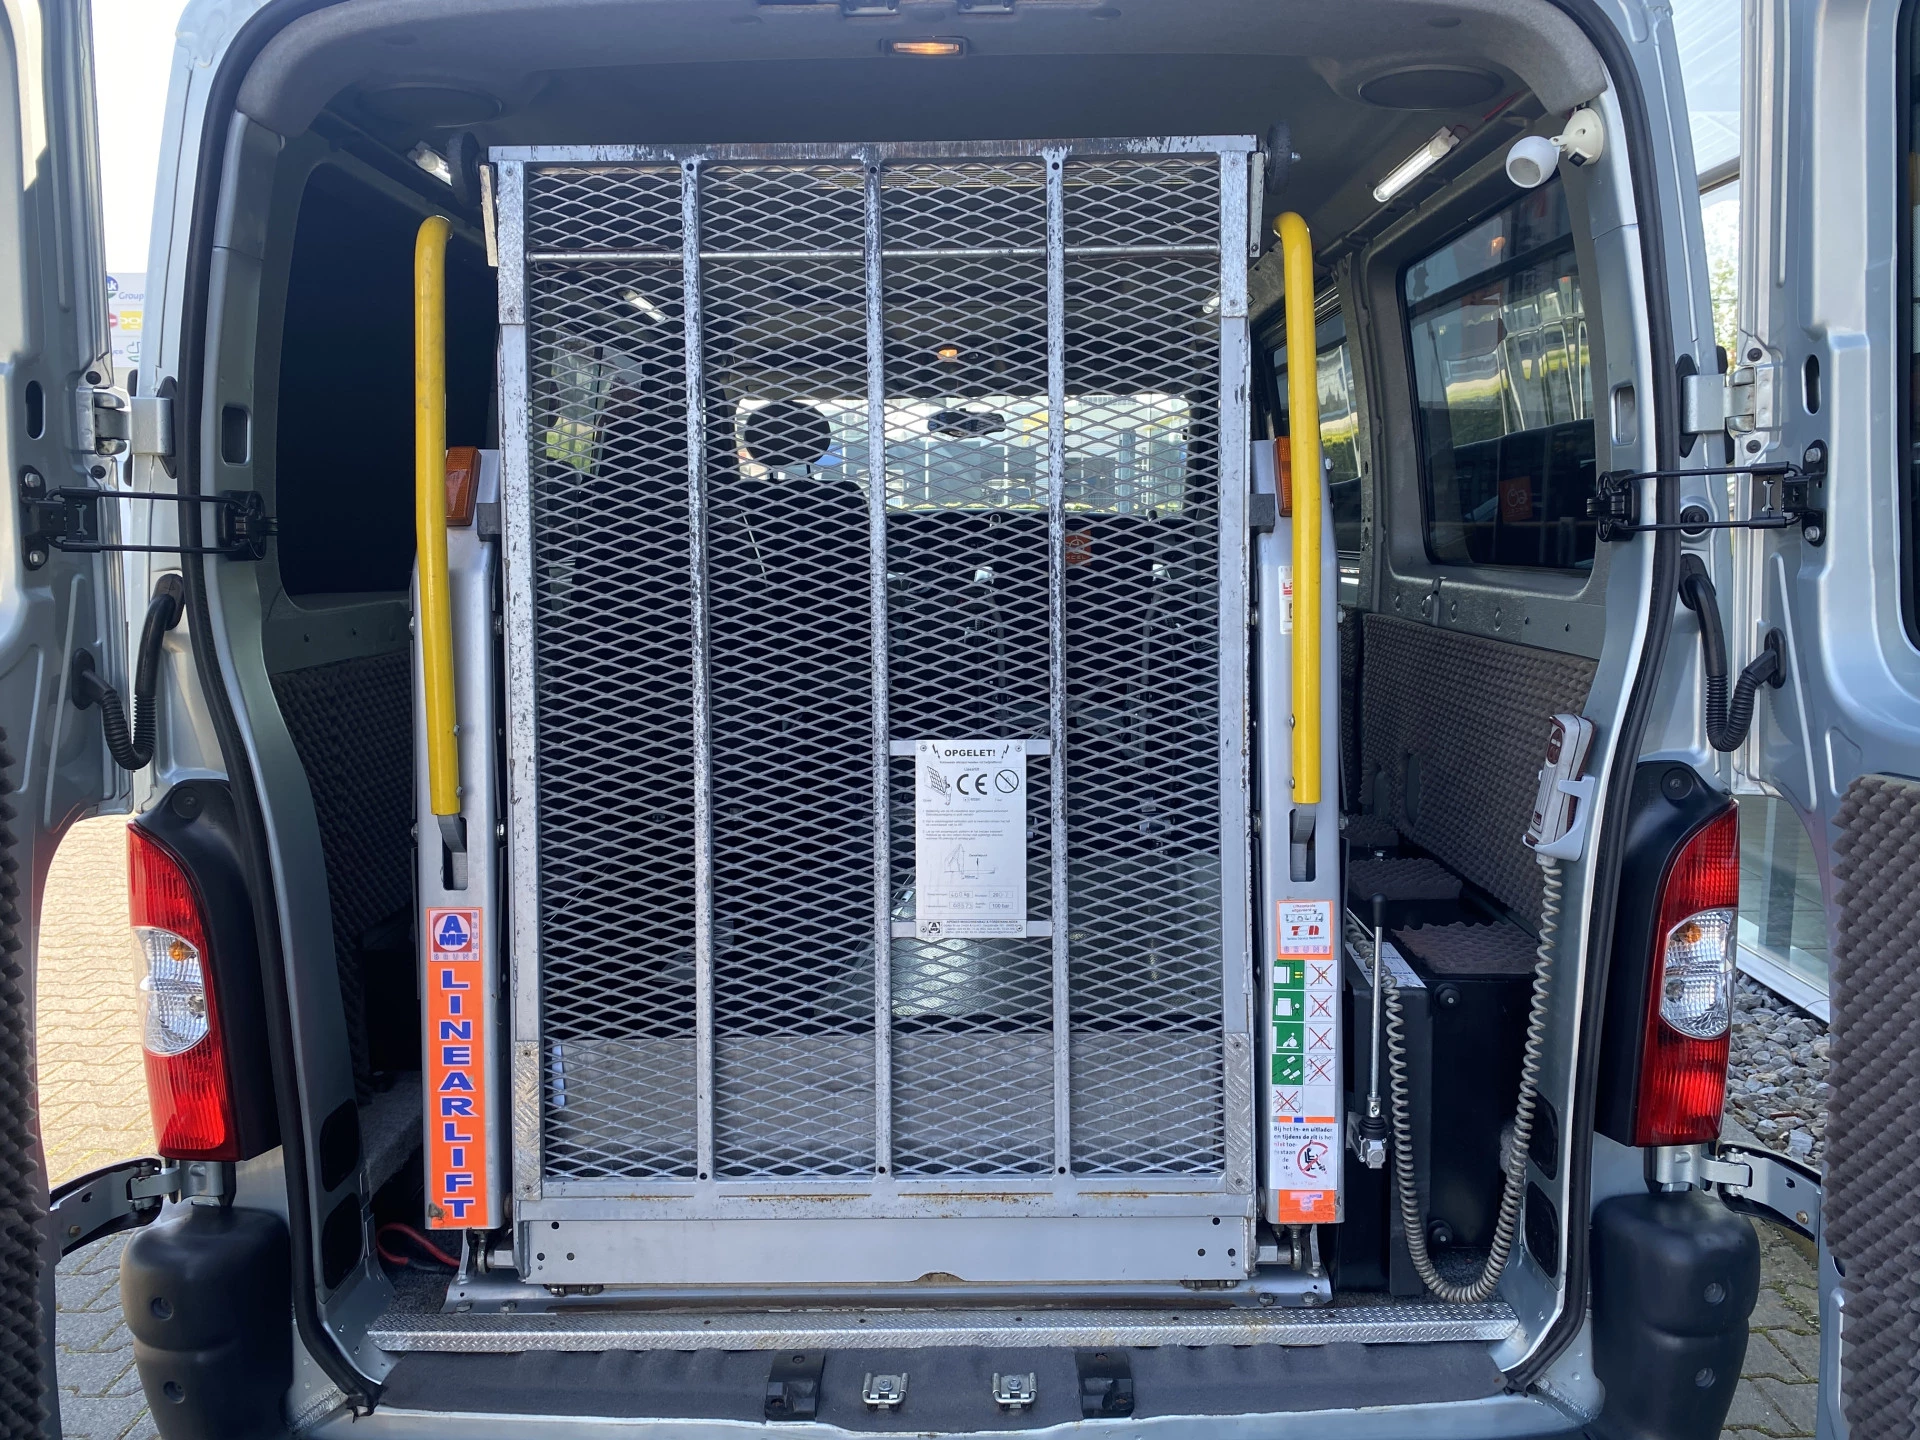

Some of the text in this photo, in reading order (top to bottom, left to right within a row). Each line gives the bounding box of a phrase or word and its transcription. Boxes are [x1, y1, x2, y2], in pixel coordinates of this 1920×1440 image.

[119, 292, 145, 301] Group
[944, 749, 996, 757] OPGELET!
[438, 969, 477, 1218] LINEARLIFT
